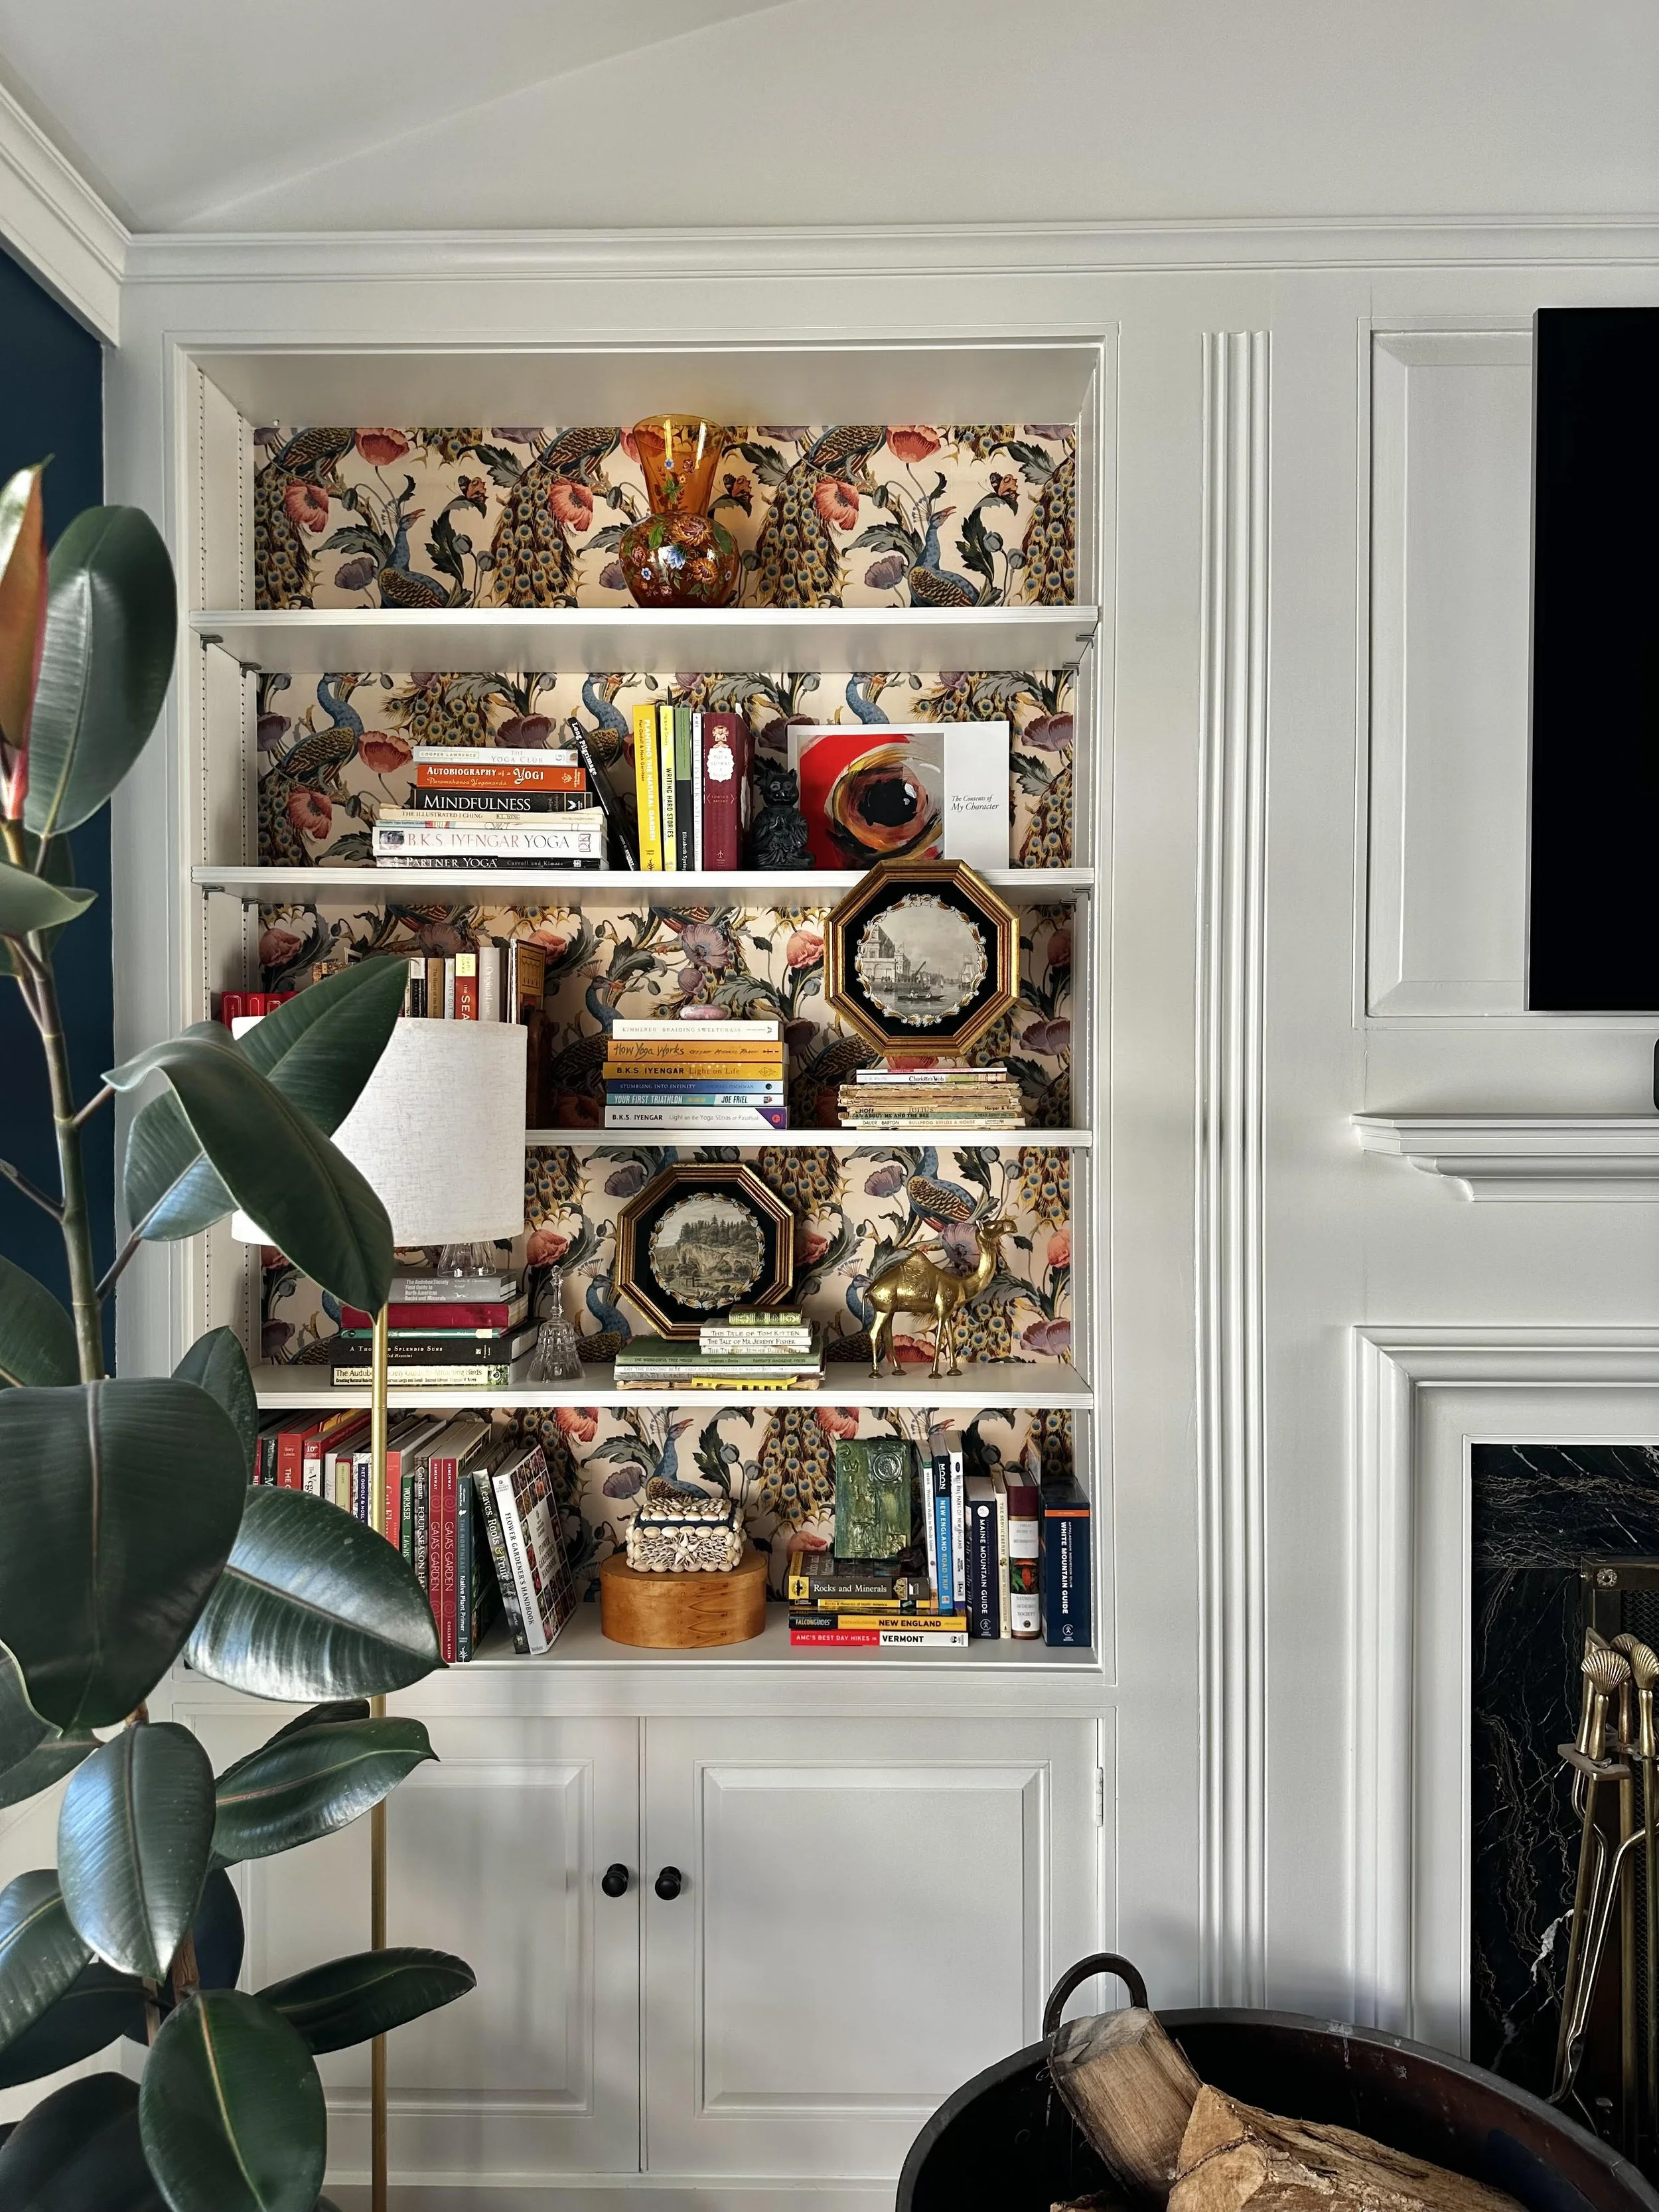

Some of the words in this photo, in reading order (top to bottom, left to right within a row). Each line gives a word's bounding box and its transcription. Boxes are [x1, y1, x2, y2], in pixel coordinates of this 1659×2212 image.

[571, 721, 582, 740] Long
[579, 739, 597, 776] Pilgrimage
[644, 719, 652, 757] PLANTING
[427, 767, 496, 776] AUTOBIOGRAPHY
[513, 767, 544, 784] YOGI
[423, 794, 531, 810] MINDFULNESS
[646, 774, 655, 808] NATURAL
[986, 794, 994, 802] of
[950, 802, 964, 813] My
[966, 802, 999, 810] Character
[452, 834, 520, 848] IYENGAR
[524, 835, 569, 848] YOGA
[406, 857, 458, 867] PARTNER
[463, 857, 498, 867] YOGA
[483, 966, 494, 997] Original
[614, 1042, 634, 1056] How
[634, 1042, 654, 1061] Yoga
[657, 1043, 684, 1059] Works
[614, 1095, 630, 1104] YOUR
[632, 1095, 649, 1104] FIRST
[651, 1095, 683, 1104] TRIATHLON
[431, 1521, 441, 1550] GAIA'S
[445, 1521, 454, 1550] GAIA'S
[487, 1518, 501, 1545] Roots
[496, 1555, 510, 1581] Fruit
[431, 1552, 440, 1591] GARDEN
[445, 1552, 454, 1591] GARDEN
[504, 1512, 516, 1541] FLOWER
[512, 1543, 526, 1585] GARDENER'S
[520, 1587, 534, 1625] HANDBOOK
[855, 1584, 887, 1593] Minerals
